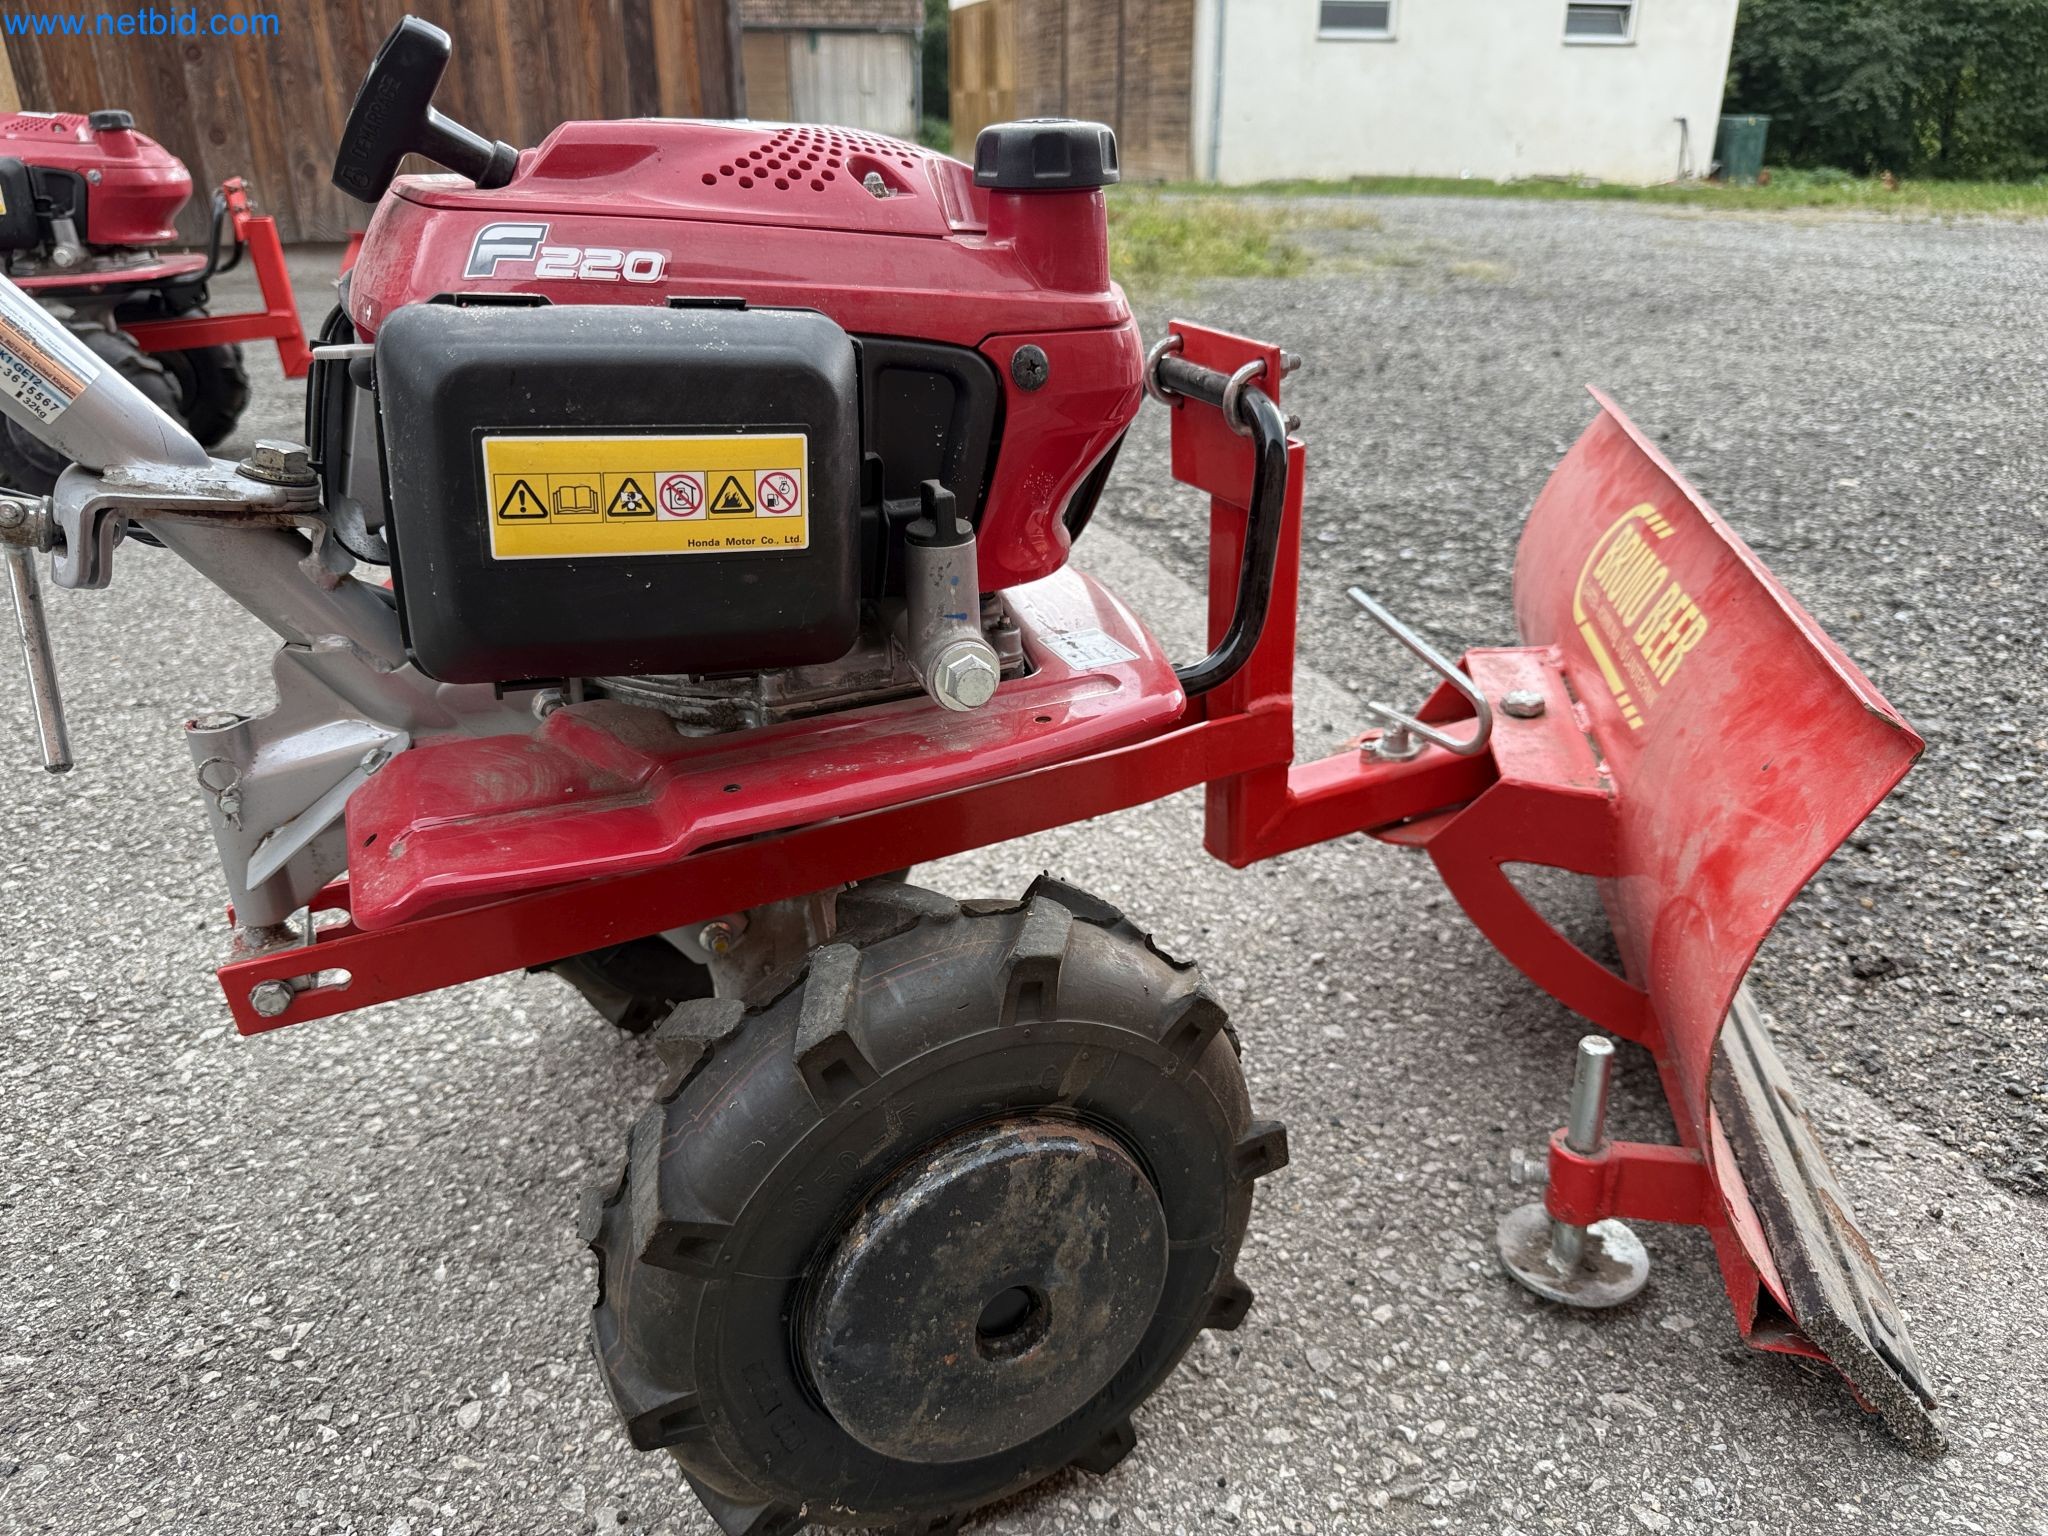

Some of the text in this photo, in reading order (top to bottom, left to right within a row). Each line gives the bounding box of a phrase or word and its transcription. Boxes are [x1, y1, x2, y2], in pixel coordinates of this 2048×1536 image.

[464, 222, 666, 283] F220
[13, 362, 42, 387] GET2
[50, 376, 77, 397] Kingdom
[22, 396, 47, 419] 32kg
[687, 535, 802, 548] Honda Motor Co., Ltd.
[1592, 523, 1709, 687] BRUNO BEER
